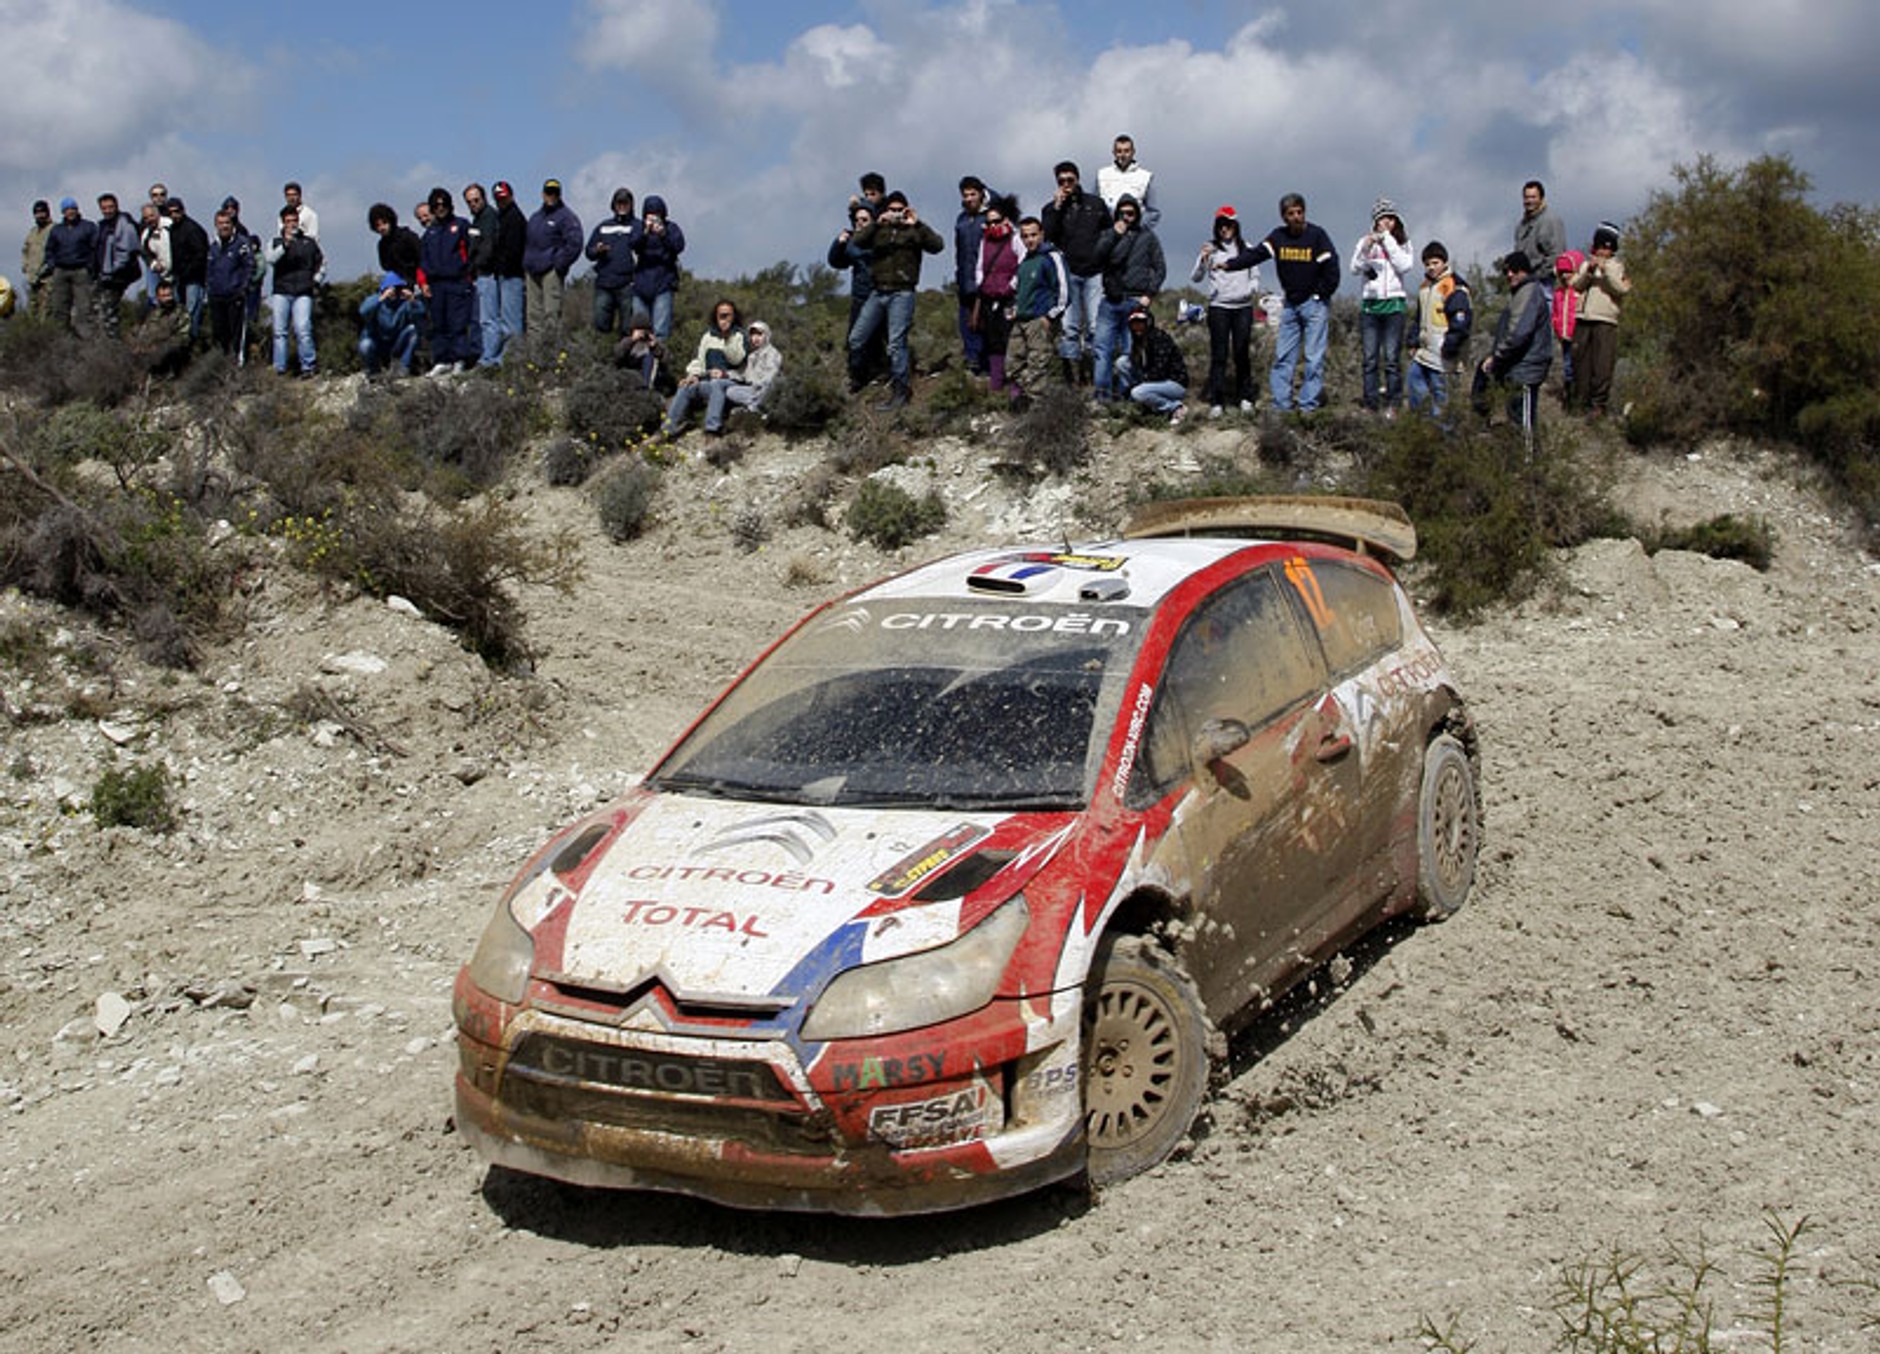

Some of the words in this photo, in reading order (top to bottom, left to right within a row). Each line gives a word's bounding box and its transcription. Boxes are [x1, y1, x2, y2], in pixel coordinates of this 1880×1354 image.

[622, 900, 769, 938] TOTAL
[832, 1048, 946, 1092] MARSY
[873, 1090, 978, 1130] FFSA
